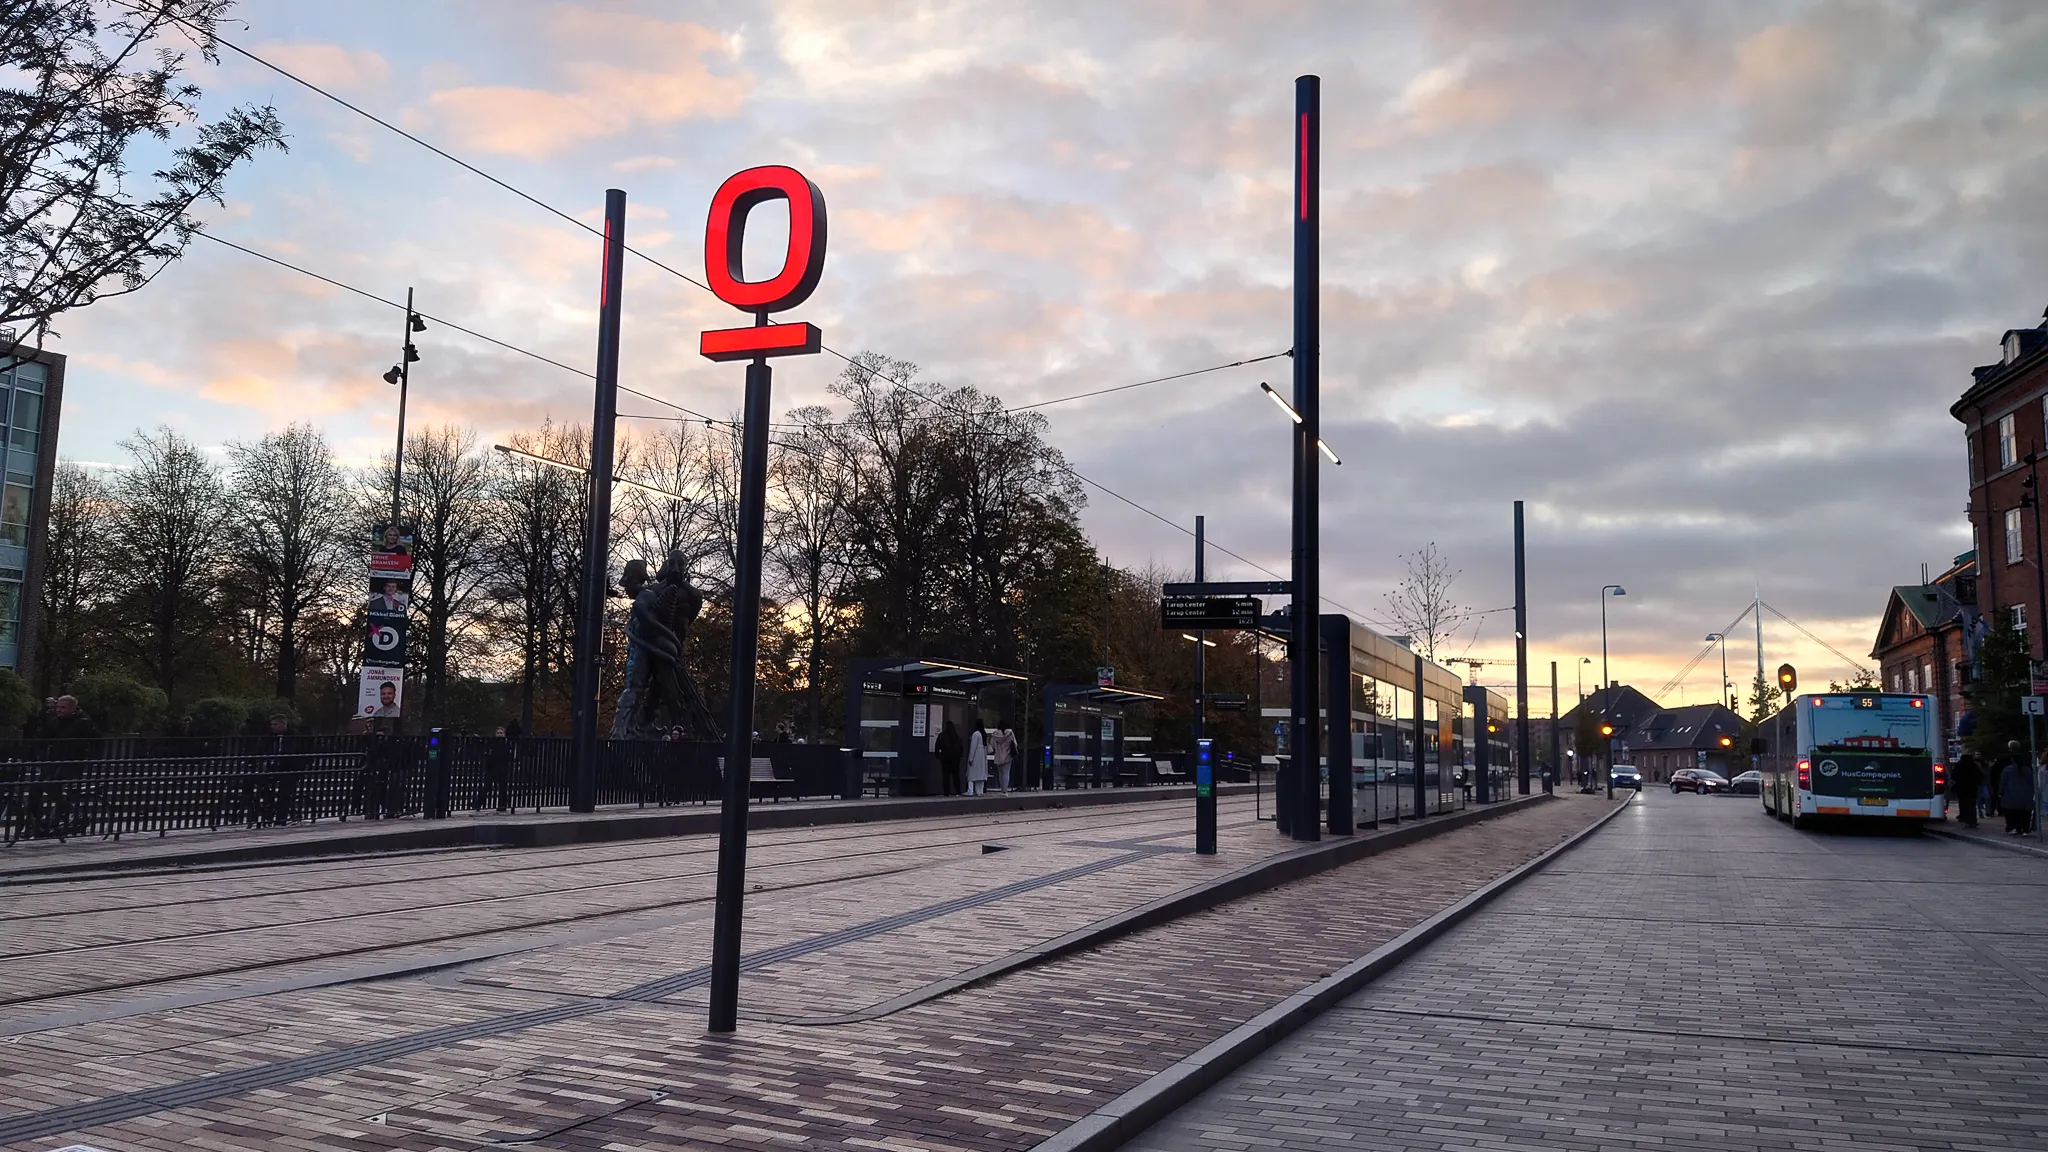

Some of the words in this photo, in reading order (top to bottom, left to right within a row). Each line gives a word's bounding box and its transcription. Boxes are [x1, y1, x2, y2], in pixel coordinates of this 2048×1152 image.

[1862, 698, 1873, 707] 55
[2028, 700, 2038, 712] C
[1841, 771, 1902, 779] HusCompagniet
